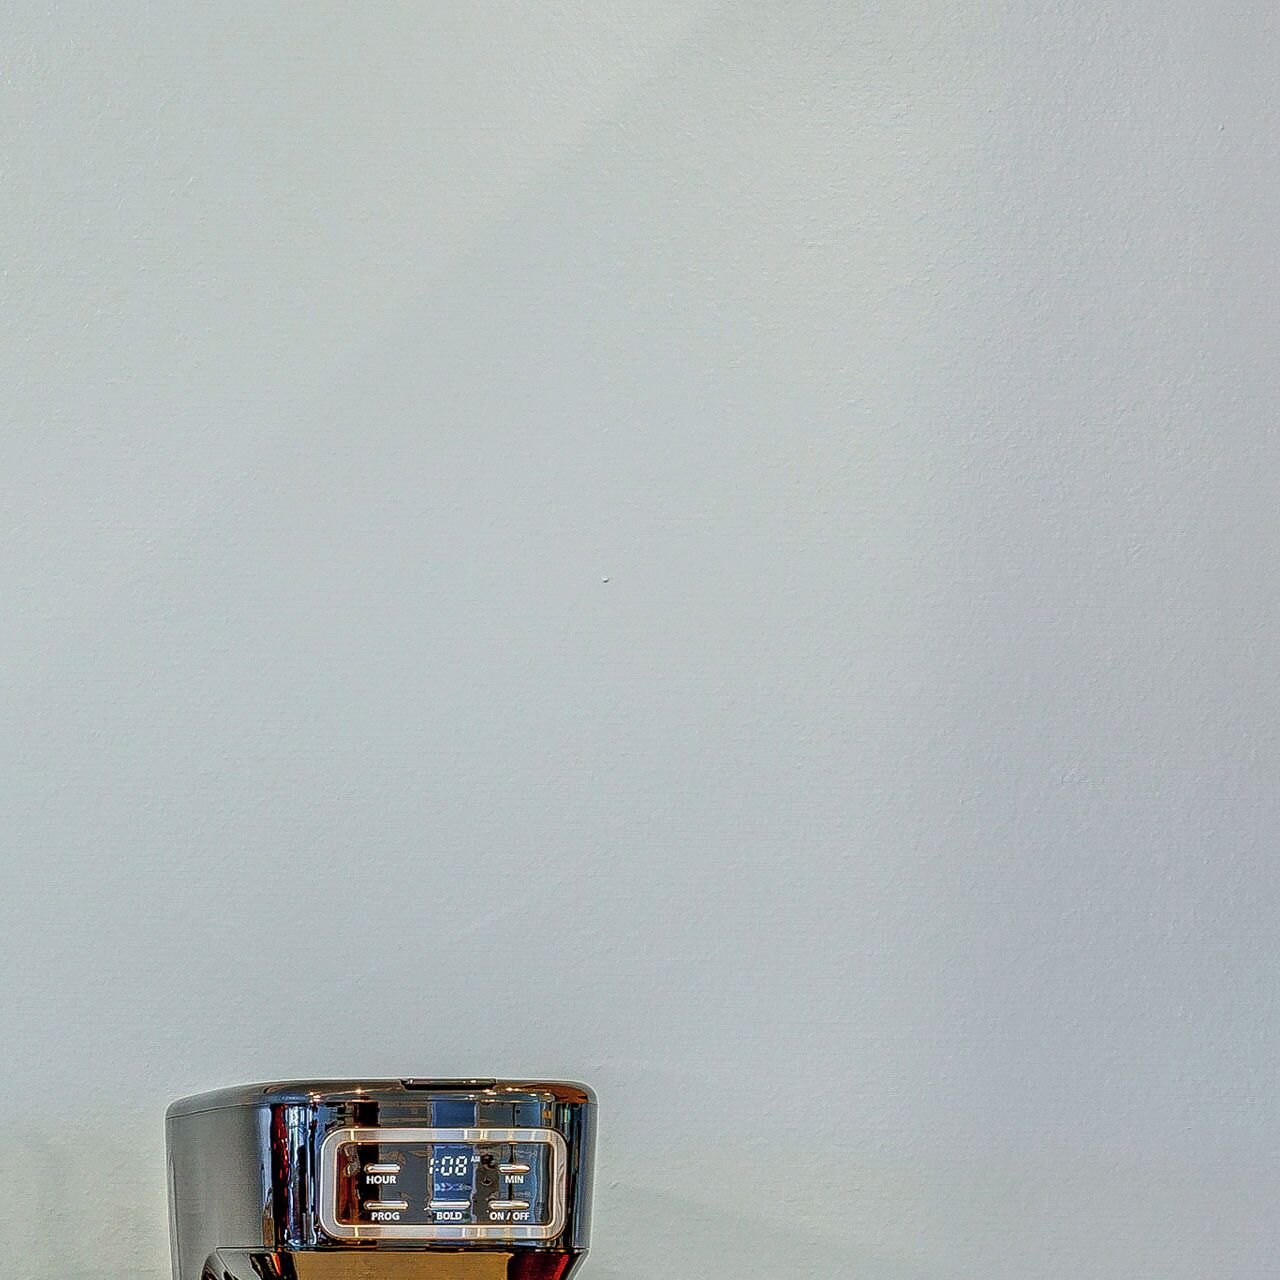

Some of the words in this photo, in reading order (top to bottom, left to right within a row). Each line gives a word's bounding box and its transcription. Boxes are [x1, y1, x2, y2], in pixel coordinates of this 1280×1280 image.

[429, 1155, 468, 1177] 1:08
[366, 1174, 397, 1185] HOUR
[505, 1174, 524, 1185] MIN
[371, 1211, 401, 1222] PROG
[436, 1211, 463, 1221] BOLD
[489, 1211, 505, 1221] ON
[512, 1211, 530, 1221] OFF
